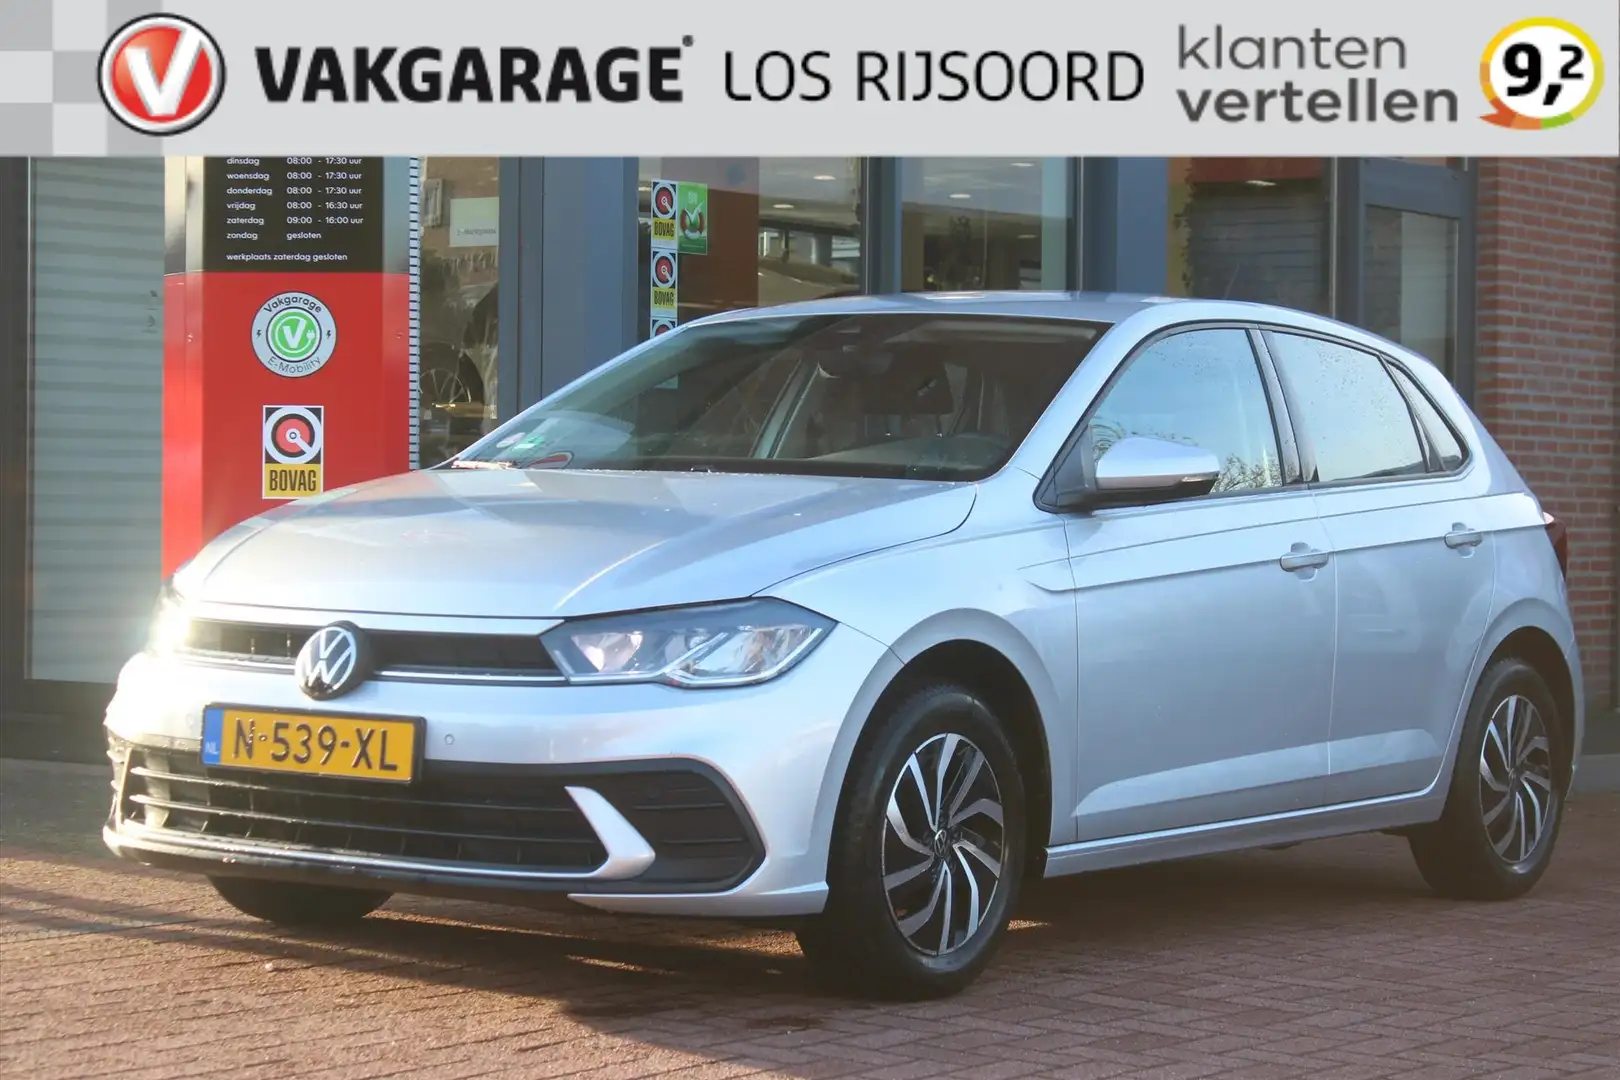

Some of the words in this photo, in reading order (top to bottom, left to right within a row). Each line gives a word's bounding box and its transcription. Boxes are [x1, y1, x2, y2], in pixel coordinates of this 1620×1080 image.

[226, 157, 260, 166] dinsdag
[286, 157, 313, 165] 08:00
[325, 157, 347, 165] 17:30
[226, 172, 270, 181] woensdag
[286, 172, 313, 180] 08:00
[325, 172, 347, 180] 17:30
[226, 187, 273, 196] donderdag
[286, 187, 313, 195] 08:00
[325, 187, 347, 195] 17:30
[226, 202, 256, 211] vrijdag
[286, 202, 313, 210] 08:00
[325, 202, 348, 210] 16:30
[226, 217, 265, 226] zaterdag
[286, 217, 313, 225] 09:00
[325, 217, 349, 225] 16:00
[226, 232, 258, 240] zondag
[286, 232, 322, 240] gesloten
[226, 253, 272, 262] werkplaats
[273, 253, 311, 262] zaterdag
[312, 253, 348, 262] gesloten
[263, 295, 322, 314] Vakgarage
[267, 356, 322, 374] E-Mobility
[269, 469, 317, 492] BOVAG
[232, 716, 399, 772] N-539-XL
